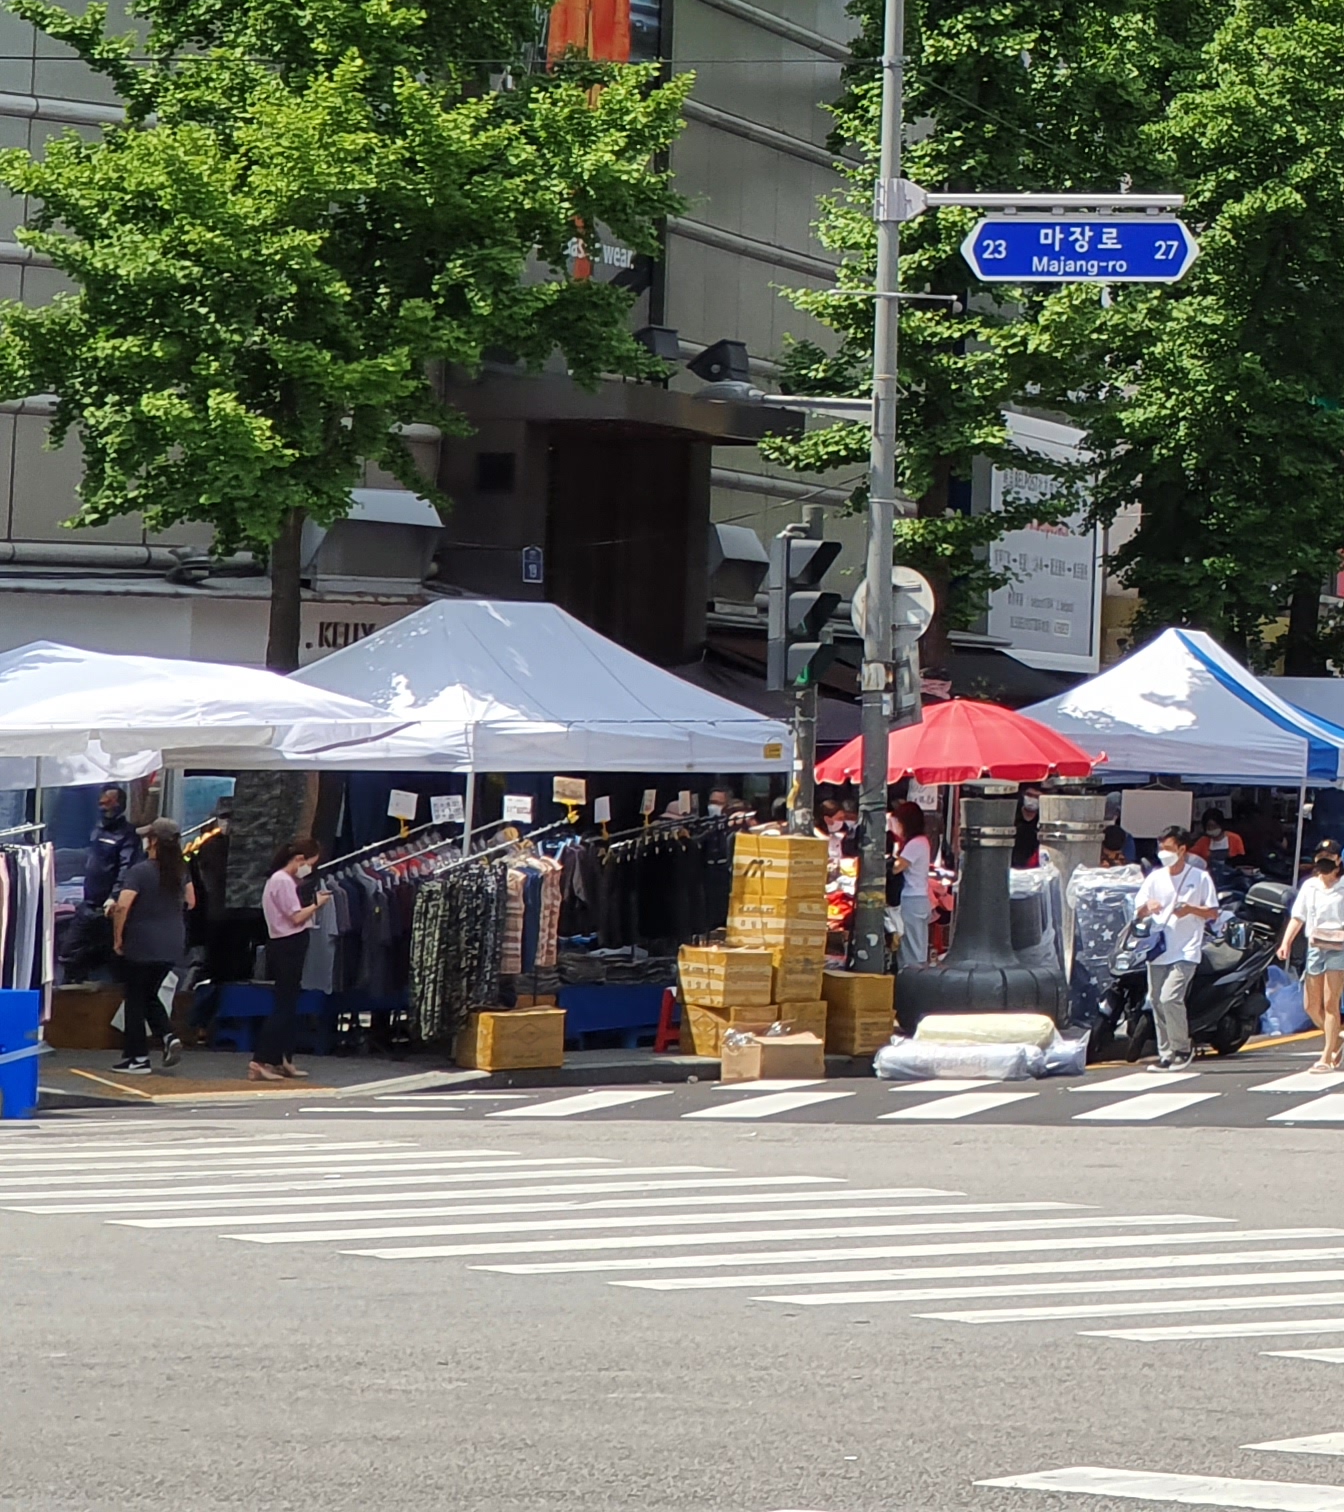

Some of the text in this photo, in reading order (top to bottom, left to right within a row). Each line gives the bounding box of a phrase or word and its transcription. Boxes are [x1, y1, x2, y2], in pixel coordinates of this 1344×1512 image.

[982, 239, 1007, 259] 23
[1039, 225, 1122, 253] 마장로
[602, 244, 634, 269] wear.
[1154, 240, 1178, 260] 27
[1031, 255, 1128, 276] Majang-ro
